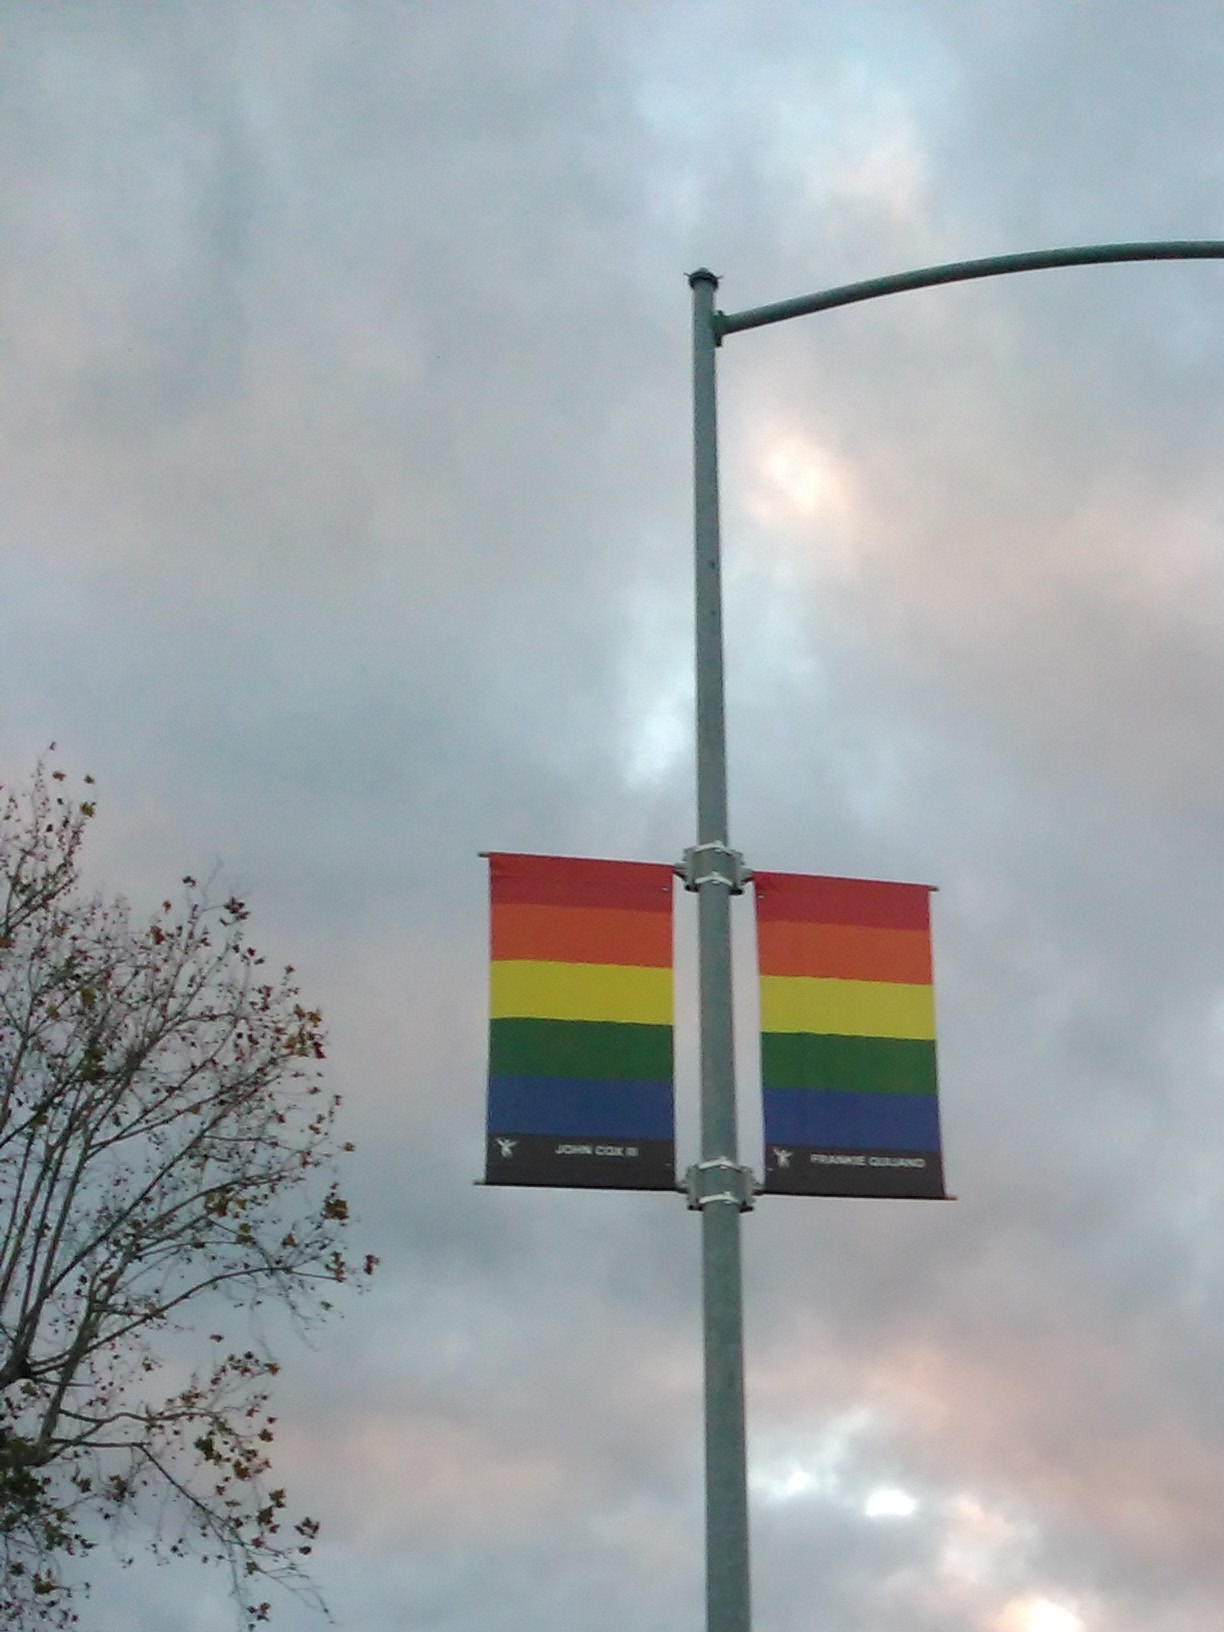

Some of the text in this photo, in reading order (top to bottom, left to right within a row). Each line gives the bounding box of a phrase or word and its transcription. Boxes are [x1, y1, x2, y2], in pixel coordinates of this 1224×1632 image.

[554, 1144, 593, 1155] JOHN
[594, 1145, 625, 1157] COX
[809, 1153, 867, 1166] FRANKIE
